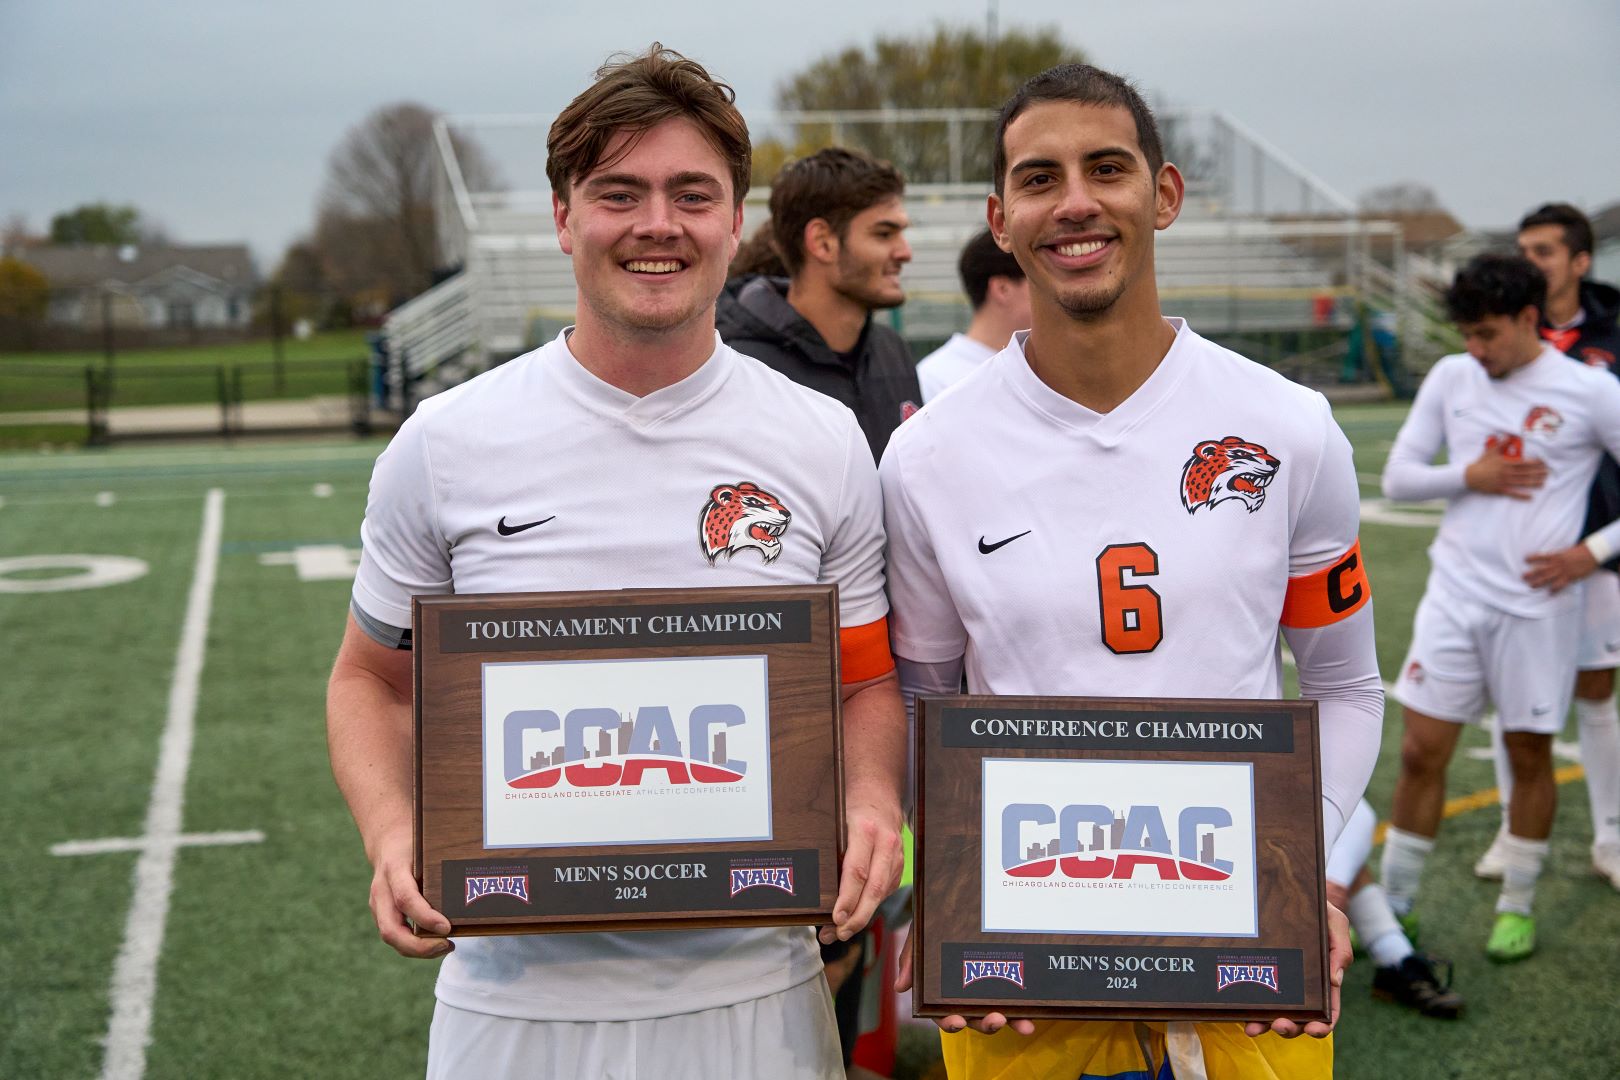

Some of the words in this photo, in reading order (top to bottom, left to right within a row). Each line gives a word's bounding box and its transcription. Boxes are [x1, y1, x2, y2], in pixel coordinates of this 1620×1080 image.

[1326, 552, 1363, 614] C
[1095, 541, 1164, 655] 6
[466, 617, 642, 640] TOURNAMENT
[648, 612, 783, 635] CHAMPION
[970, 718, 1130, 738] CONFERENCE
[1135, 721, 1264, 740] CHAMPION
[503, 703, 748, 790] CCAC
[505, 791, 572, 800] CHICAGOLAND
[574, 789, 632, 798] COLLEGIATE
[636, 788, 681, 796] ATHLETIC
[683, 785, 747, 795] CONFERENCE
[1001, 803, 1235, 881] CCAC
[553, 865, 619, 883] MEN'S
[623, 863, 708, 881] SOCCER
[731, 867, 793, 895] NAIA
[1002, 880, 1067, 888] CHICAGOLAND
[1068, 881, 1123, 889] COLLEGIATE
[1172, 883, 1234, 891] CONFERENCE
[466, 876, 529, 904] NAIA
[615, 886, 648, 900] 2024
[964, 960, 1023, 986] NAIA
[1047, 955, 1110, 971] MEN'S
[1114, 956, 1196, 973] SOCCER
[1106, 976, 1138, 989] 2024
[1217, 965, 1277, 990] NAIA
